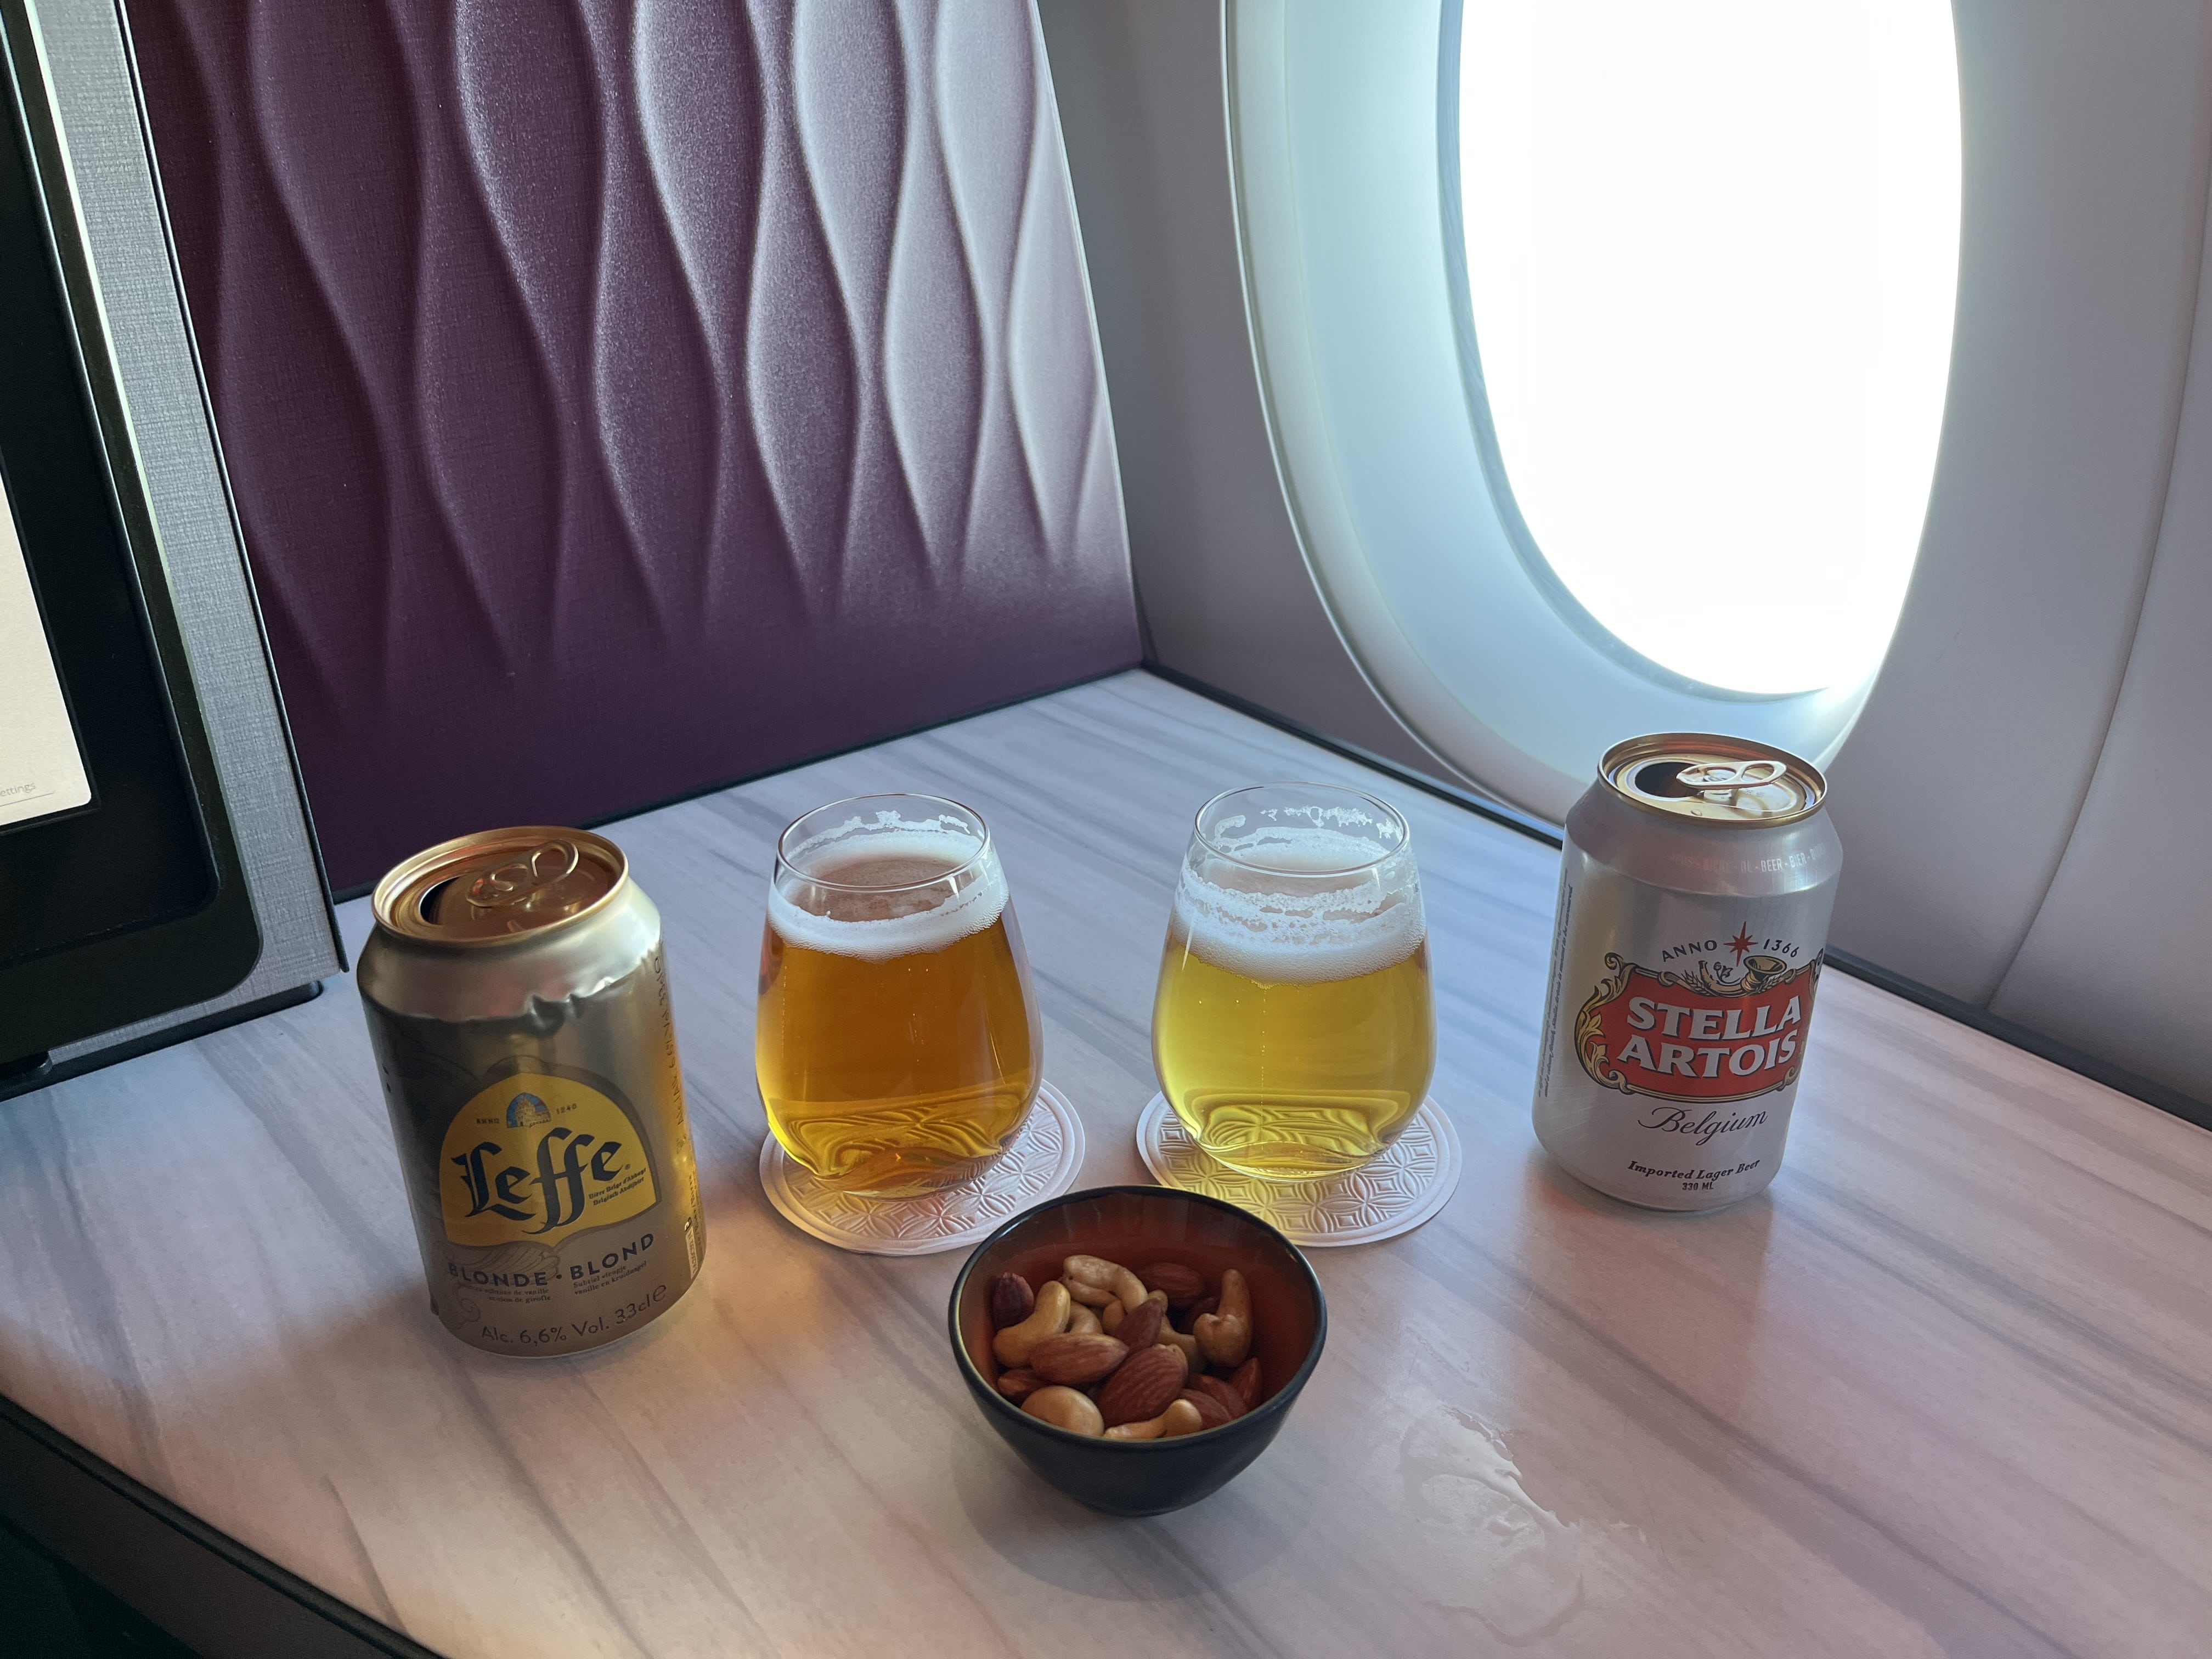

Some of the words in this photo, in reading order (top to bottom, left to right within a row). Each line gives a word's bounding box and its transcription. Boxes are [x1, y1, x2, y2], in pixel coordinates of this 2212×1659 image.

[1761, 859, 1783, 872] BEER
[1789, 853, 1807, 868] BIER
[1662, 940, 1717, 962] ANNO
[1764, 939, 1799, 957] 1366
[1627, 995, 1802, 1041] STELLA
[1617, 1029, 1799, 1079] ARTOIS
[1638, 1107, 1768, 1146] Belgium
[451, 1127, 623, 1235] Leffe
[1627, 1160, 1695, 1180] Imported
[1696, 1168, 1734, 1181] Lager
[1735, 1160, 1760, 1174] Beer
[1682, 1182, 1699, 1190] 330
[1701, 1182, 1714, 1190] ML
[448, 1262, 548, 1288] BLONDE
[569, 1233, 654, 1280] BLOND
[482, 1325, 514, 1344] Alc.
[520, 1327, 567, 1347] 6,6%
[571, 1317, 610, 1338] Vol.
